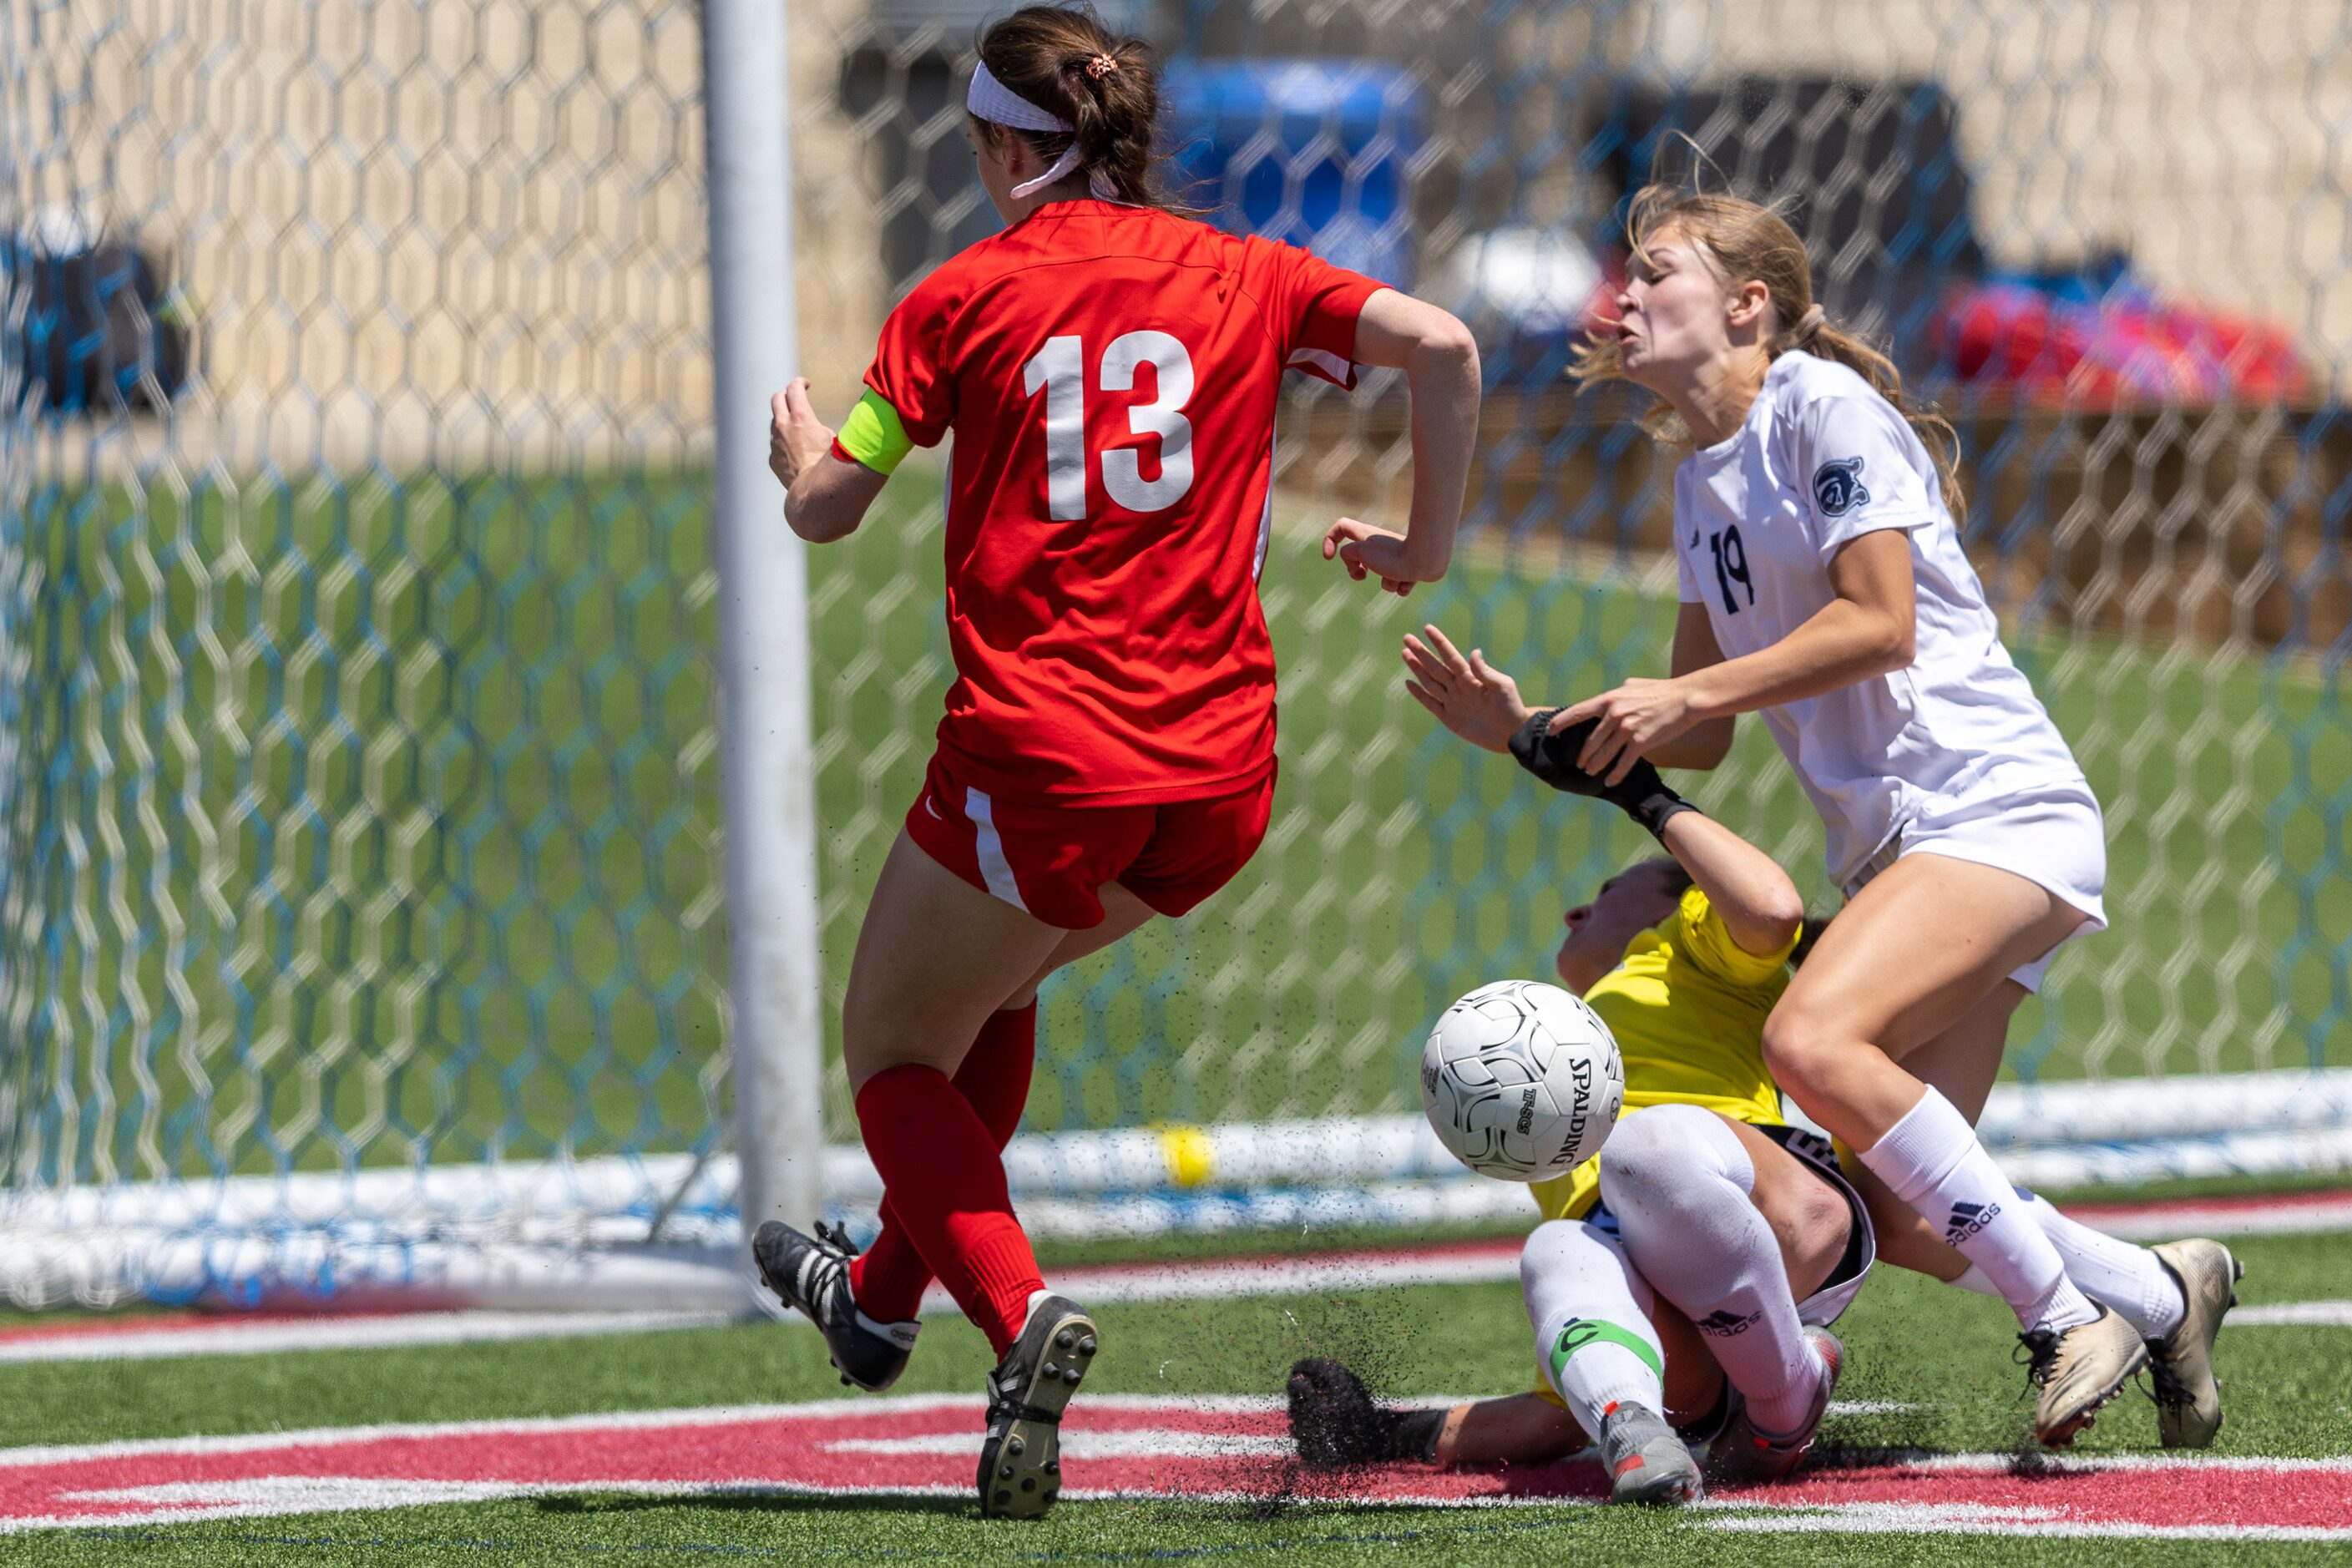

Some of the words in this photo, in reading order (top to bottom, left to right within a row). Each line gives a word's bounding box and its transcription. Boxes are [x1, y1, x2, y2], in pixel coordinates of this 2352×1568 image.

[1023, 330, 1195, 521] 13
[1710, 524, 1755, 615] 19
[1547, 1058, 1592, 1166] SPALDING
